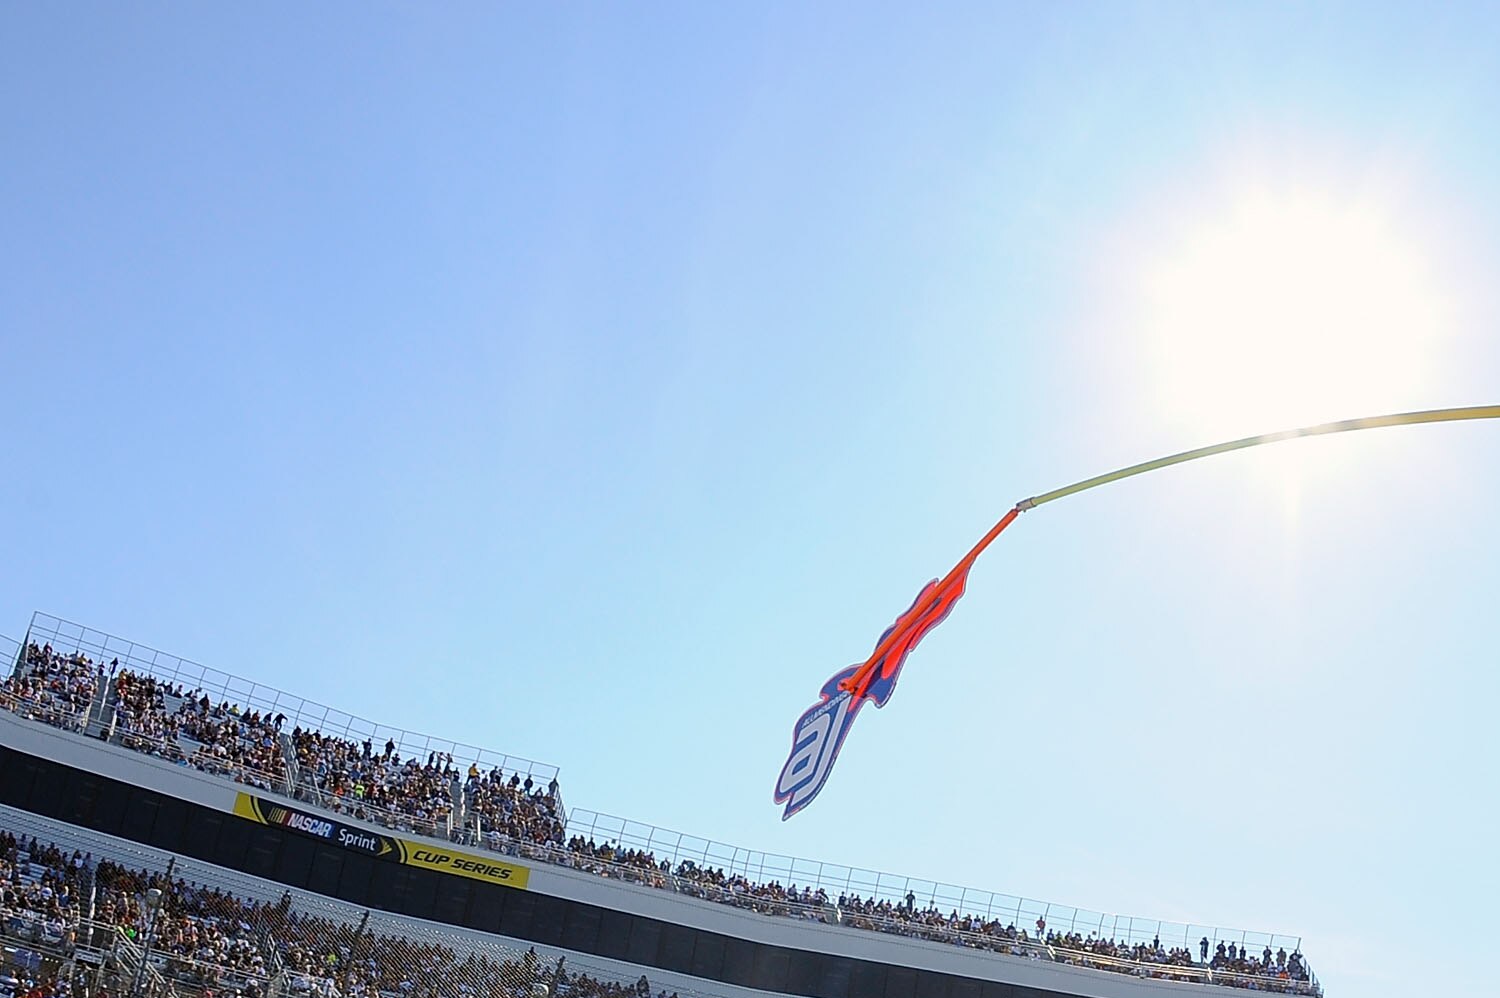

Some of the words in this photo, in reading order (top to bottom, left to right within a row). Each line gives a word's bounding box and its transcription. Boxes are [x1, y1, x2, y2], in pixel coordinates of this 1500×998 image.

[288, 812, 332, 838] NASCAR
[338, 828, 377, 852] Sprint
[413, 849, 450, 865] CUP
[451, 859, 514, 880] SERIES
